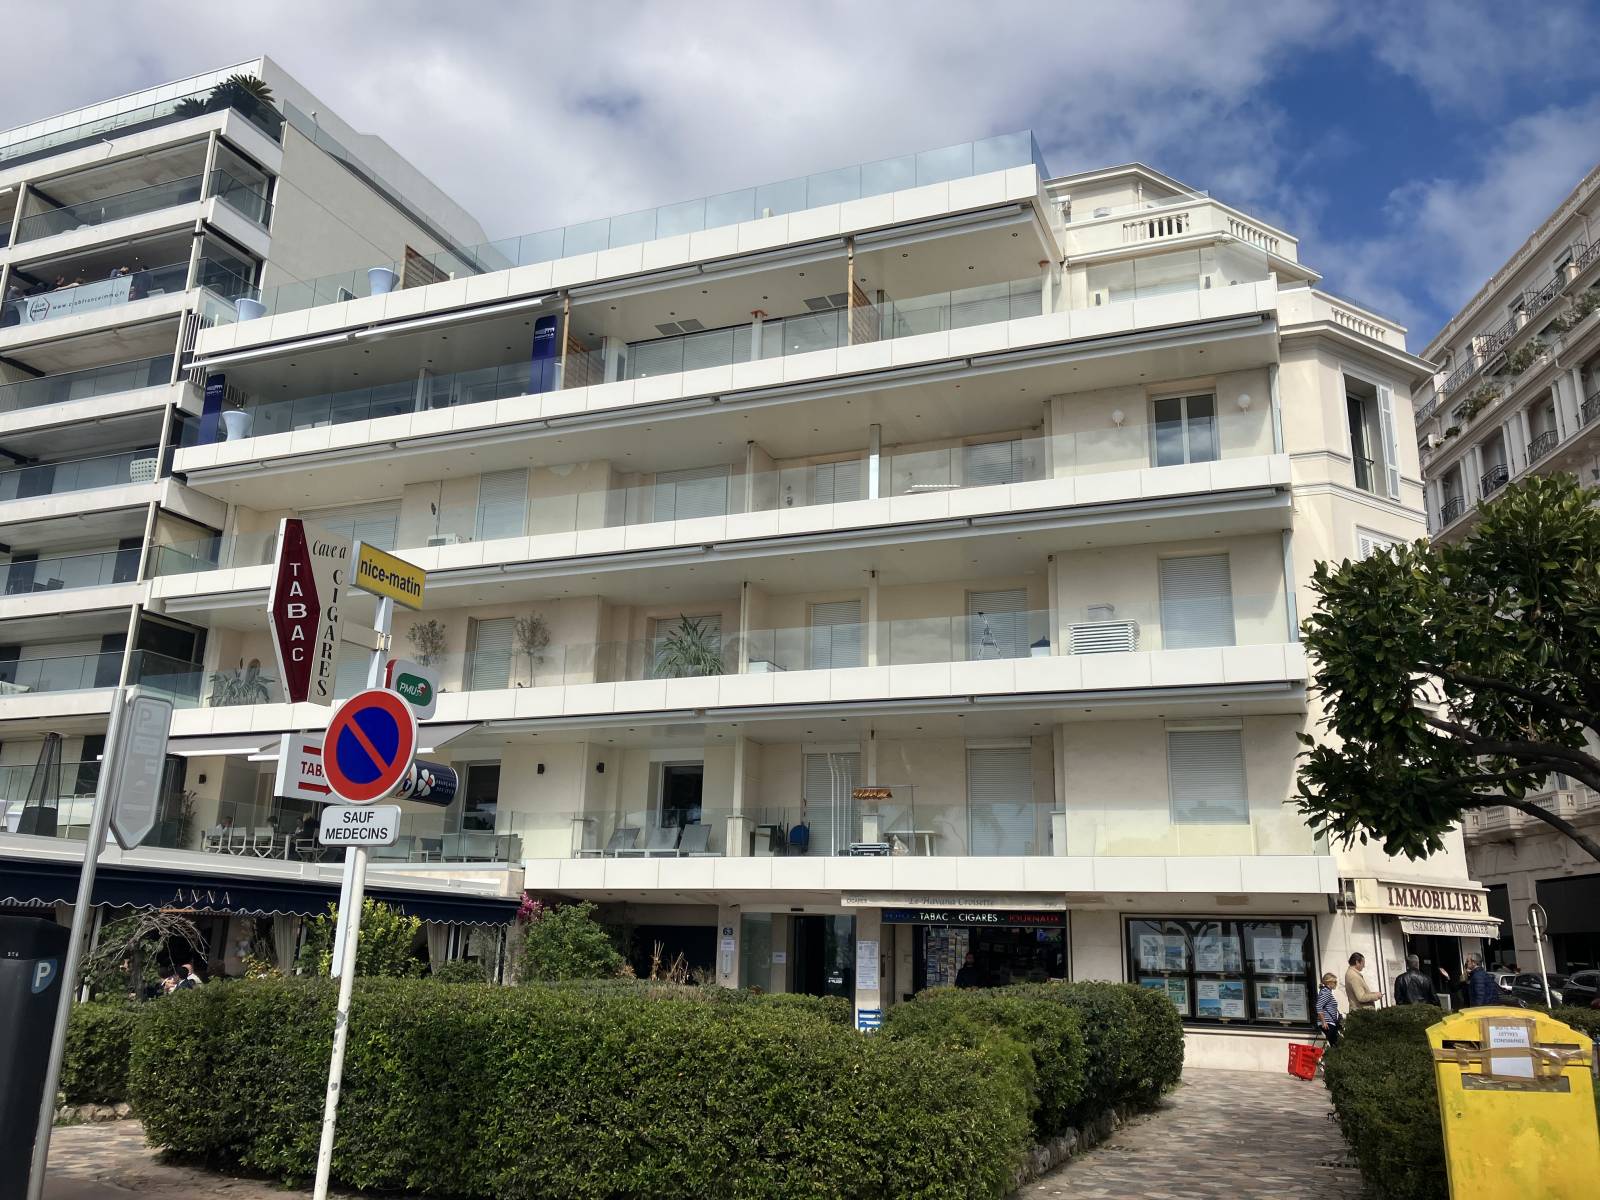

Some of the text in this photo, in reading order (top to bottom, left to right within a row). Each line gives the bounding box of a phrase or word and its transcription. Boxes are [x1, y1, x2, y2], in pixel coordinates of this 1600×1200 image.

[360, 558, 421, 597] nice-matin
[287, 562, 308, 662] TABAC
[317, 569, 343, 697] CIGARES
[399, 681, 418, 696] PMU
[301, 760, 325, 778] TAB
[342, 811, 375, 823] SAUF
[325, 827, 388, 840] MEDECINS
[173, 888, 230, 905] ANNA
[1387, 887, 1481, 912] IMMOBILIER
[919, 912, 949, 921] TABAC
[958, 913, 998, 922] CIGARES
[722, 927, 734, 936] 63
[35, 962, 51, 988] P
